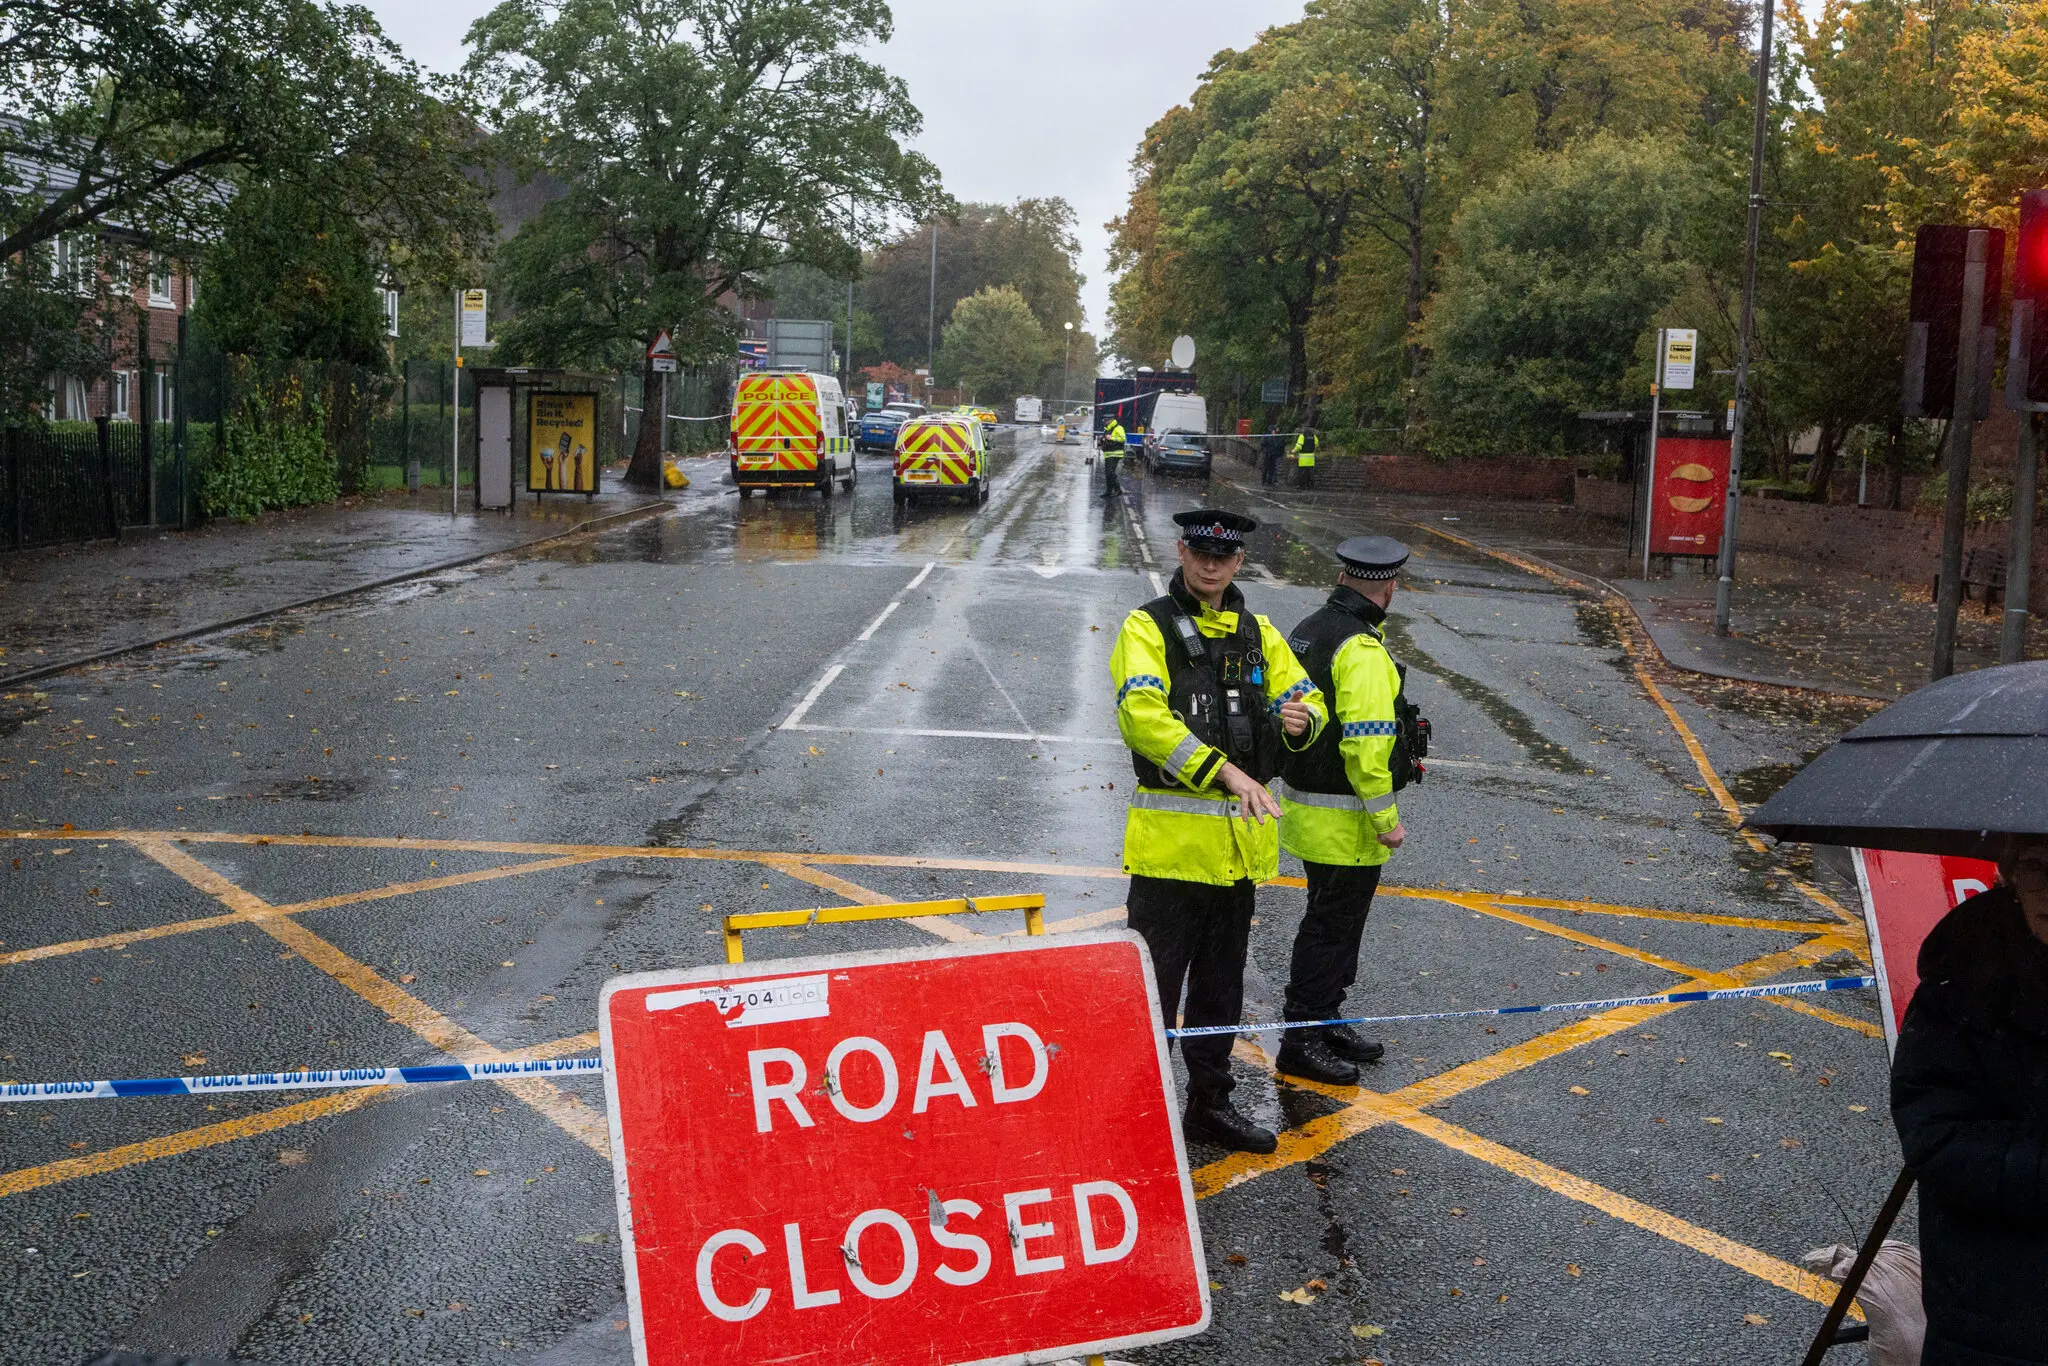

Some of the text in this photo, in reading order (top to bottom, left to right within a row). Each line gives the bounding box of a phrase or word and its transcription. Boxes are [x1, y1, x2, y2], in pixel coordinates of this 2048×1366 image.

[743, 392, 811, 401] POLICE
[536, 409, 553, 417] Bin
[536, 418, 584, 428] Recycled!
[699, 987, 721, 996] Permit
[747, 1022, 1049, 1133] ROAD
[696, 1180, 1139, 1322] CLOSED
